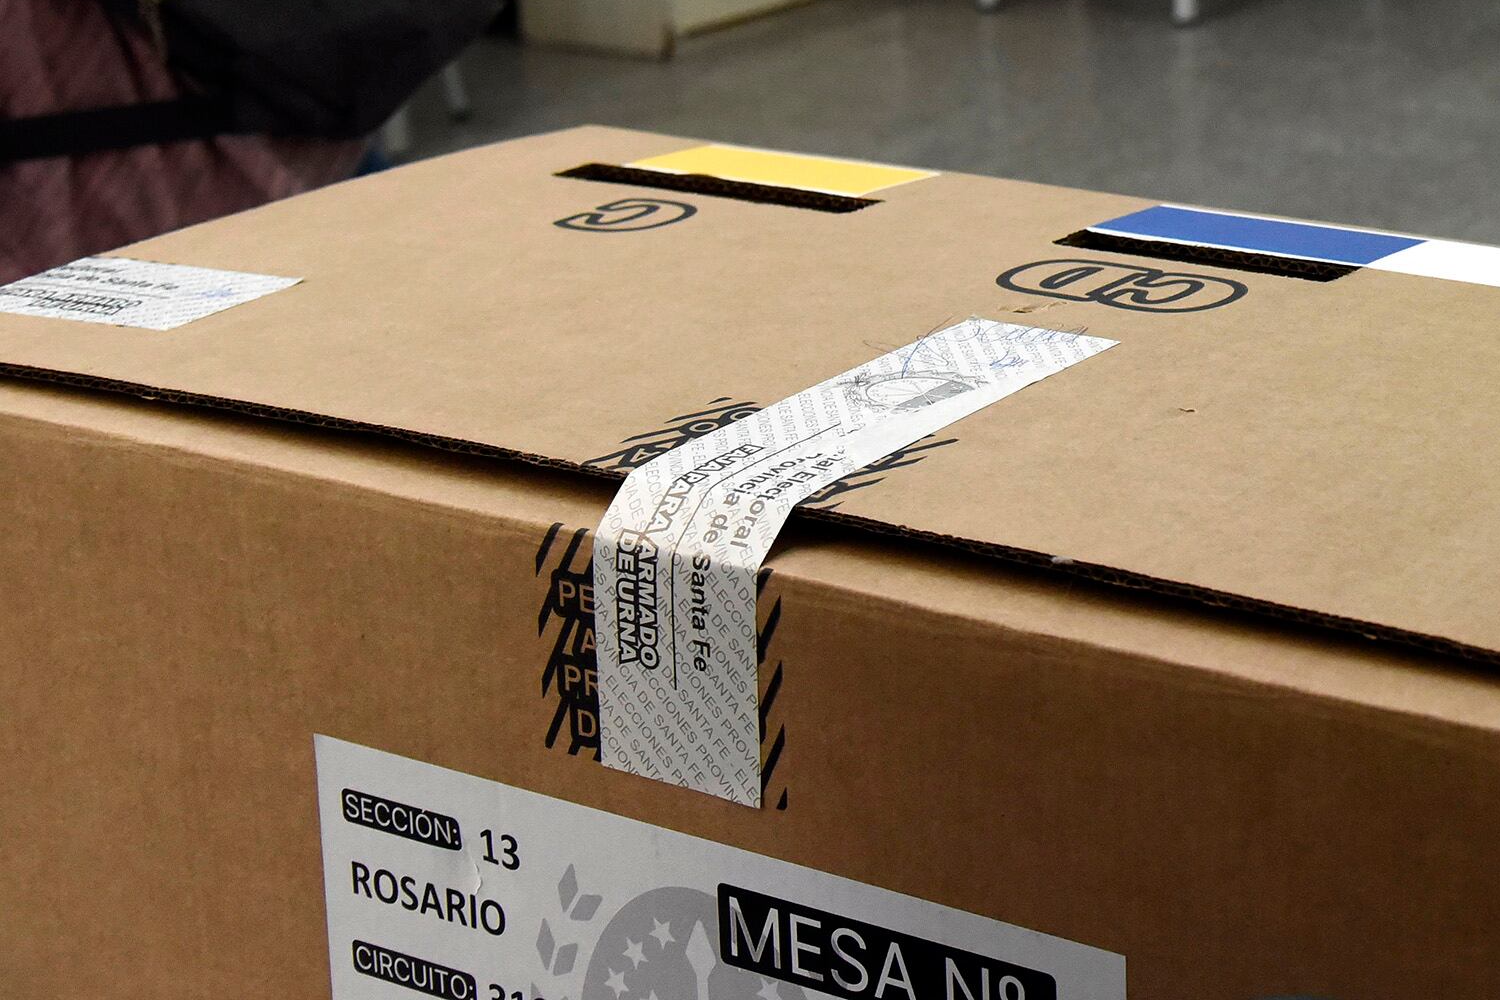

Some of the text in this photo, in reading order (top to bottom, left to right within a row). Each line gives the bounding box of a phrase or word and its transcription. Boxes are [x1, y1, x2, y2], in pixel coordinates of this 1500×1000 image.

[645, 469, 709, 535] PARA
[703, 513, 728, 545] de
[730, 471, 816, 548] Electoral
[616, 528, 640, 666] DE URNA
[637, 533, 661, 670] ARMADO
[692, 553, 711, 631] Santa
[693, 638, 711, 673] Fe
[605, 674, 673, 769] ELECCIONES
[613, 715, 632, 739] DE
[636, 690, 656, 715] DE
[653, 713, 690, 765] SANTA
[688, 762, 707, 786] FE
[678, 689, 715, 741] SANTA
[712, 737, 732, 761] FE
[344, 793, 521, 872] SECCIÓN: 13
[351, 860, 506, 937] ROSARIO
[355, 945, 475, 1000] CIRCUITO:
[729, 895, 915, 1000] MESA
